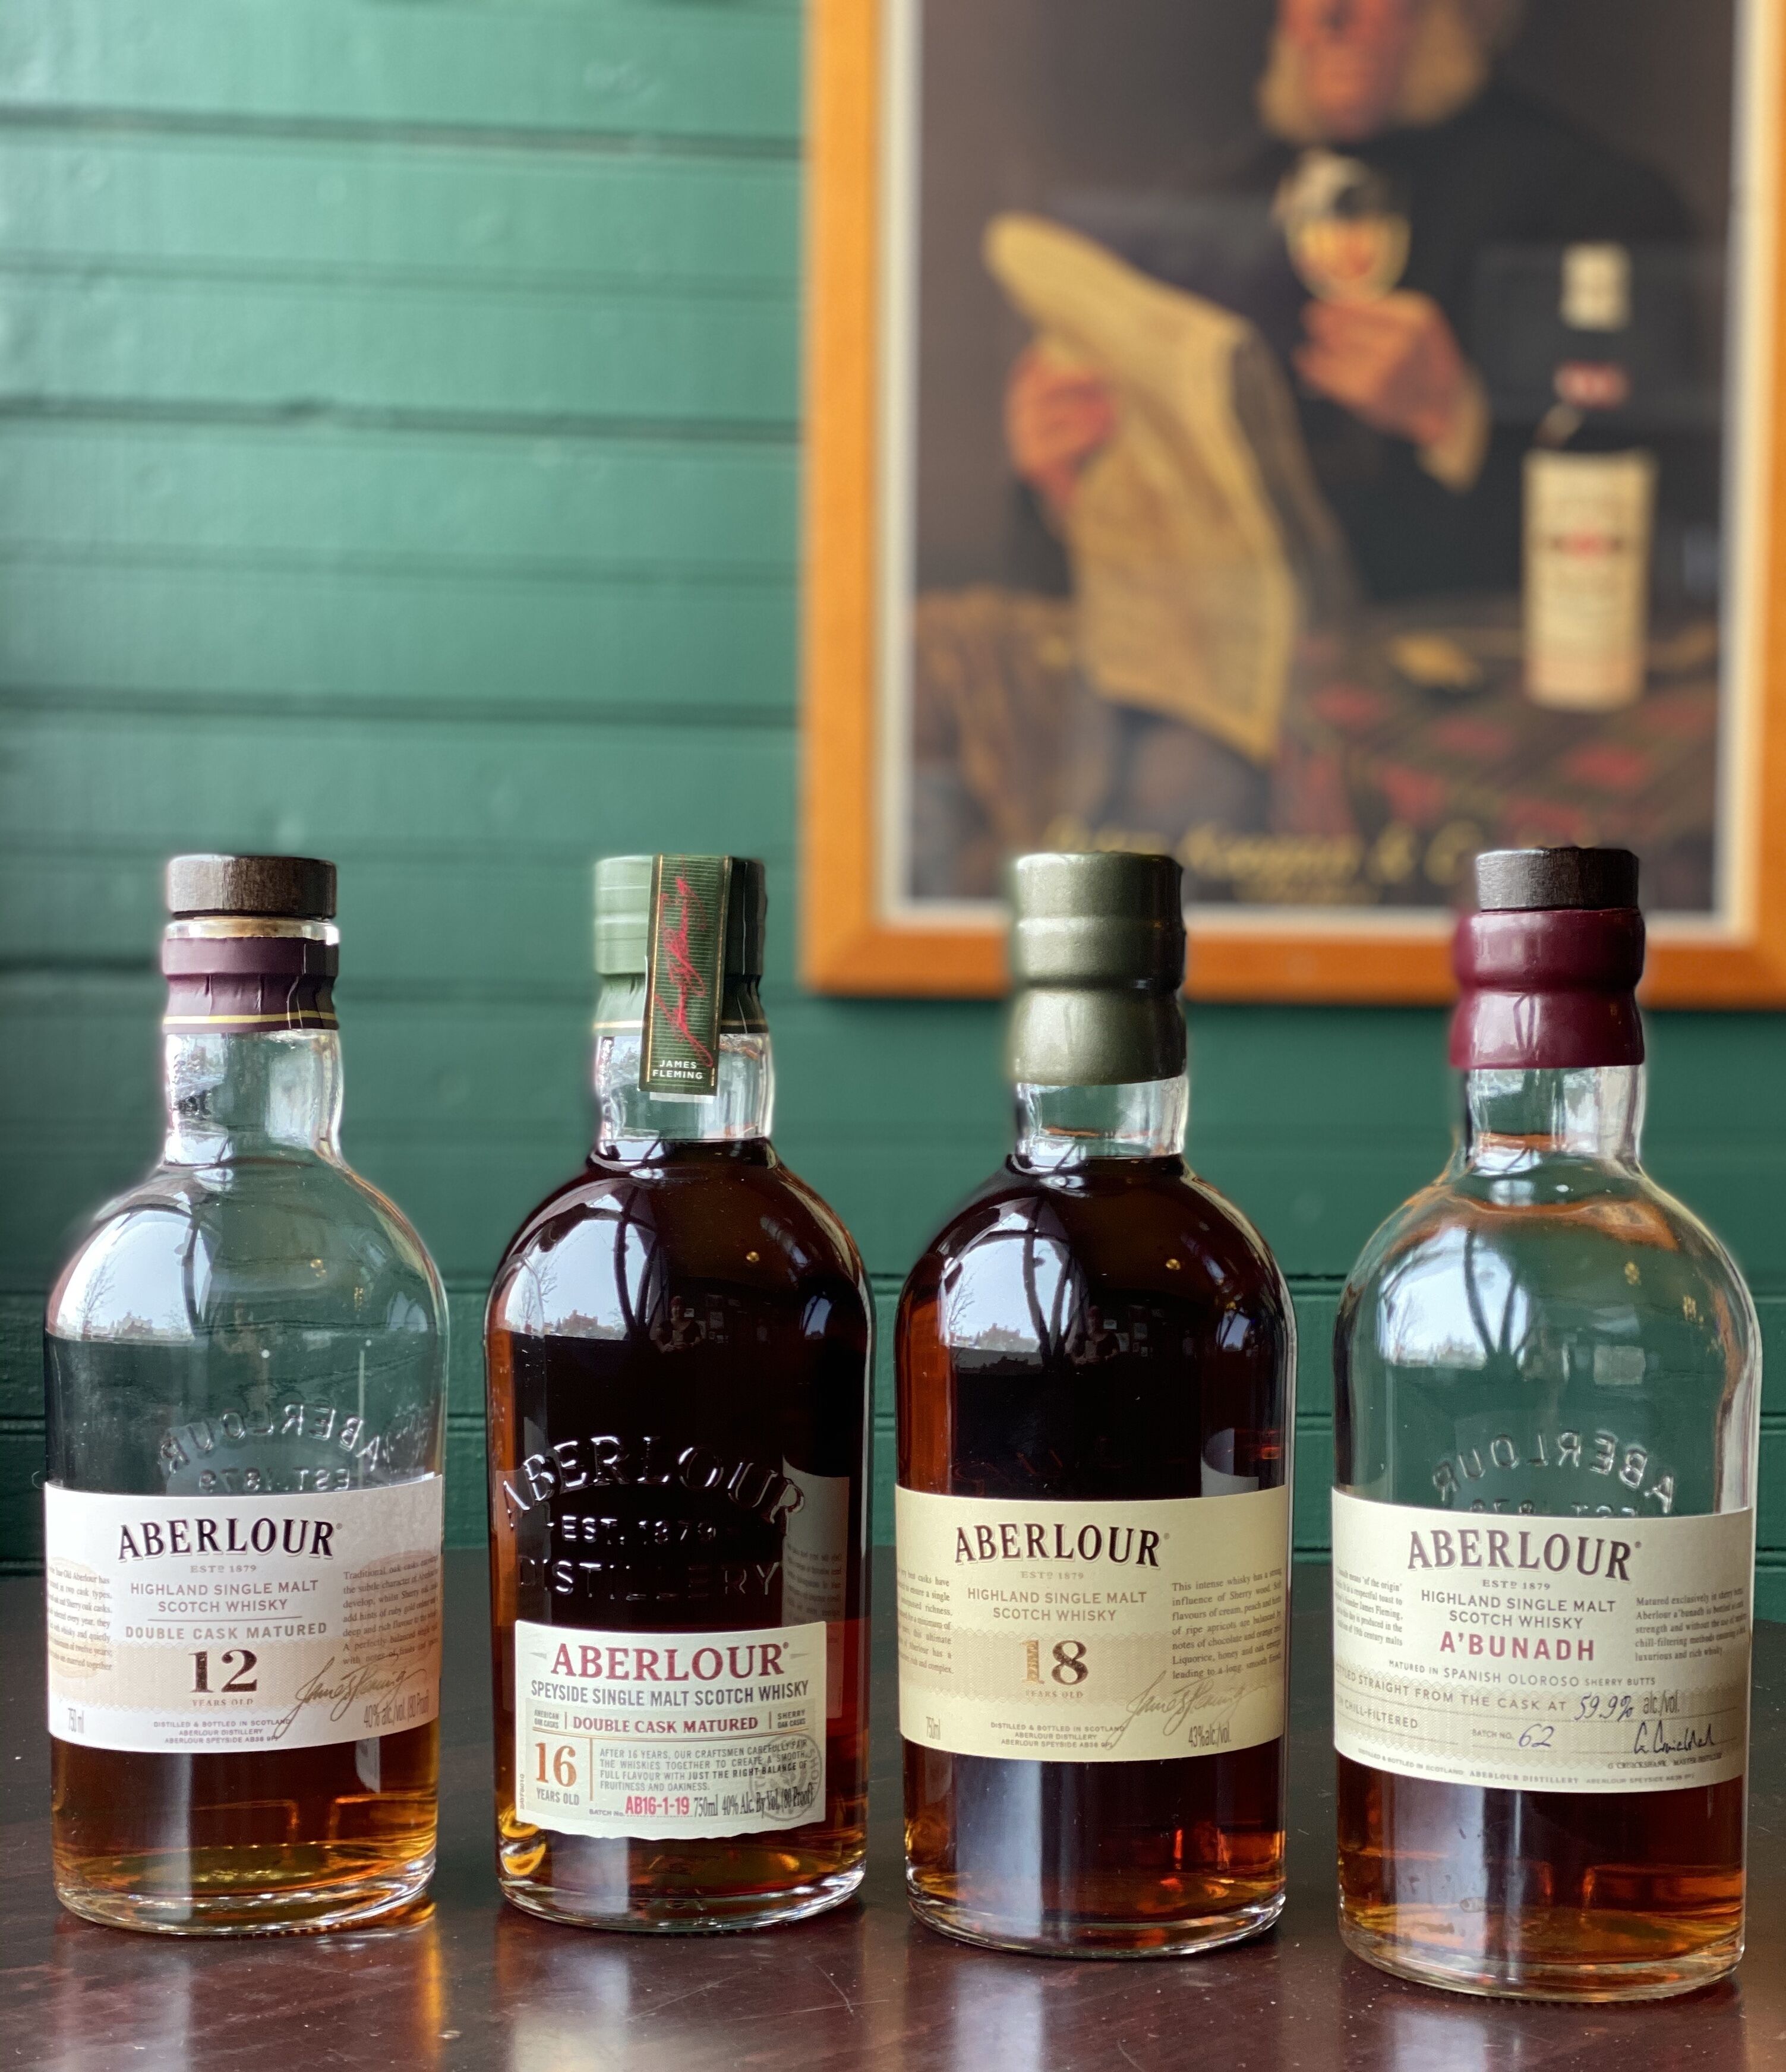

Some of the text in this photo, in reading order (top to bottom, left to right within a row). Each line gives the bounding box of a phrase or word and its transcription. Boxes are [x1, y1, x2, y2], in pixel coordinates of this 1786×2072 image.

[660, 1059, 698, 1070] JAMES
[652, 1069, 703, 1080] FLEMING
[118, 1518, 334, 1561] ABERLOUR
[954, 1523, 1160, 1568] ABERLOUR
[1408, 1528, 1631, 1582] ABERLOUR
[229, 1564, 257, 1573] 1879
[343, 1567, 386, 1580] Traditional
[98, 1575, 110, 1584] has
[935, 1576, 950, 1587] have
[1172, 1575, 1251, 1592] This intense whisky
[130, 1579, 318, 1596] HIGHLAND SINGLE MALT
[343, 1583, 380, 1594] the subtle
[932, 1591, 950, 1603] single
[968, 1587, 1147, 1604] HIGHLAND SINGLE MALT
[1172, 1589, 1252, 1607] influence of Sherry
[1421, 1589, 1616, 1613] HIGHLAND SINGLE MALT
[1636, 1595, 1670, 1606] Matured
[157, 1598, 288, 1613] SCOTCH WHISKY
[343, 1613, 357, 1623] add
[993, 1607, 1116, 1622] SCOTCH WHISKY
[1172, 1607, 1218, 1621] flavours of
[1449, 1609, 1584, 1629] SCOTCH WHISKY
[1636, 1611, 1671, 1620] Aberlour
[96, 1617, 111, 1629] they
[364, 1625, 376, 1635] and
[1172, 1619, 1250, 1636] of ripe apricots are
[1635, 1622, 1683, 1635] strength and
[125, 1622, 327, 1640] DOUBLE CASK MATURED
[1172, 1635, 1242, 1650] notes of chocolate
[1635, 1638, 1688, 1648] chill-filtering
[1020, 1639, 1088, 1685] 18
[1217, 1650, 1238, 1660] honey
[1635, 1650, 1687, 1661] luxurious and
[550, 1643, 785, 1682] ABERLOUR
[188, 1649, 257, 1693] 12
[1173, 1669, 1204, 1679] leading
[1389, 1659, 1656, 1687] MATURED IN SPANISH OLOROSO SHERRY BUTTS
[531, 1679, 809, 1707] SPEYSIDE SINGLE MALT SCOTCH WHISKY
[1061, 1691, 1084, 1699] OLD
[1359, 1674, 1567, 1711] STRAIGHT FROM THE CASK AT
[192, 1699, 226, 1707] YEARS
[1574, 1692, 1634, 1723] 59.9%
[534, 1709, 559, 1720] AMERICAN
[777, 1709, 806, 1720] SHERRY
[1345, 1699, 1418, 1729] CHILL-FILTERED
[573, 1716, 759, 1734] DOUBLE CASK MATURED
[990, 1722, 1027, 1730] DISTILLED
[1015, 1732, 1054, 1740] ABERLOUR
[1472, 1729, 1497, 1739] BATCH
[1518, 1723, 1554, 1748] 62
[1001, 1738, 1039, 1747] ABERLOUR
[599, 1748, 624, 1758] AFTER
[627, 1749, 638, 1759] 16
[640, 1750, 671, 1759] YEARS,
[674, 1750, 692, 1759] OUR
[695, 1747, 743, 1759] CRAFTSMEN
[535, 1742, 577, 1787] 16
[599, 1755, 772, 1770] THE WHISKIES TOGETHER TO CREATE A
[1387, 1757, 1415, 1768] BOTTLED
[599, 1759, 808, 1781] FULL FLAVOUR WITH JUST THE RIGHT BALANCE OF
[1469, 1770, 1579, 1784] ABERLOUR DISTILLERY
[599, 1780, 710, 1792] FRUITINESS AND OAKINESS.
[537, 1787, 580, 1806] YEARS OLD
[589, 1795, 690, 1816] BATCH AB16-1-19
[694, 1792, 766, 1819] 750ml 40% By
